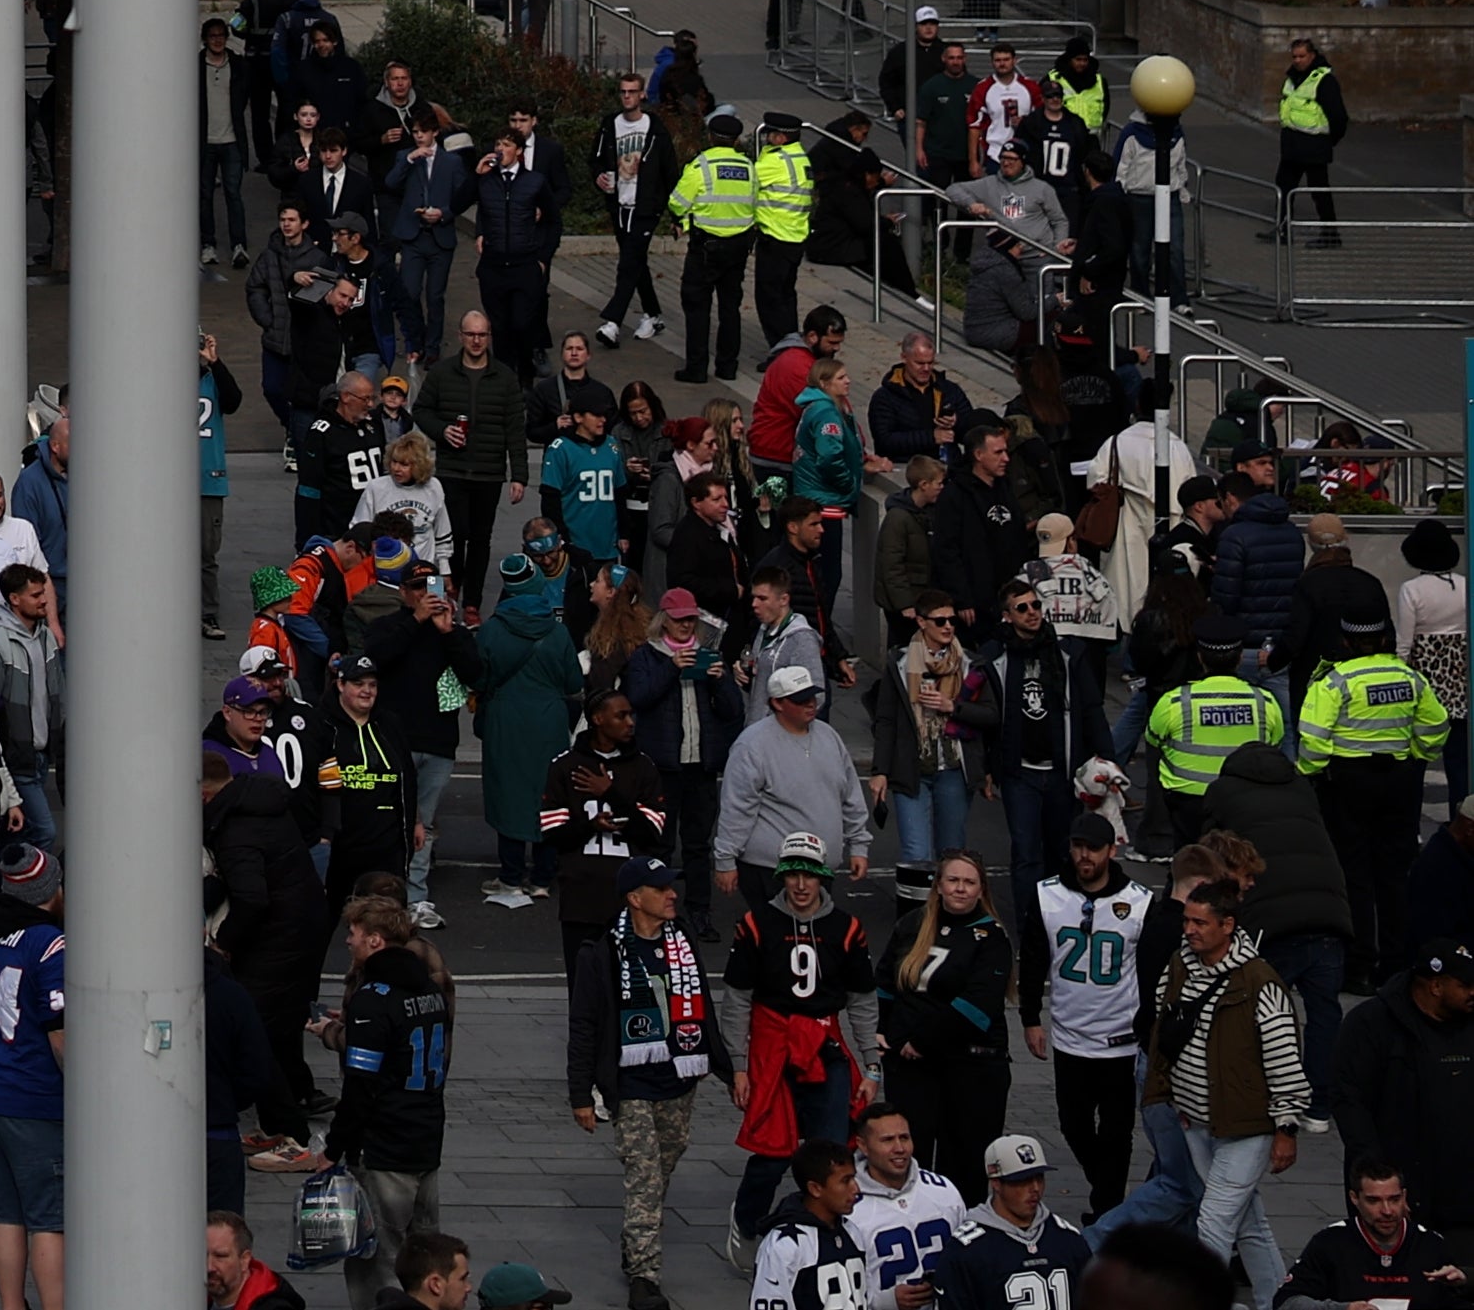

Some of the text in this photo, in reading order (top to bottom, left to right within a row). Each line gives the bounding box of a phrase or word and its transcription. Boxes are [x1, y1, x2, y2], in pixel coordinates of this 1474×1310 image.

[718, 167, 749, 180] POLICE
[1042, 139, 1071, 177] 10
[578, 469, 615, 502] 30
[1370, 687, 1414, 705] POLICE
[1201, 711, 1253, 726] POLICE
[338, 764, 365, 775] LOS
[789, 943, 818, 999] 9
[915, 945, 951, 993] 7
[1055, 926, 1125, 986] 20
[403, 993, 446, 1018] ST BROWN
[404, 1021, 445, 1091] 14
[873, 1217, 952, 1291] 22
